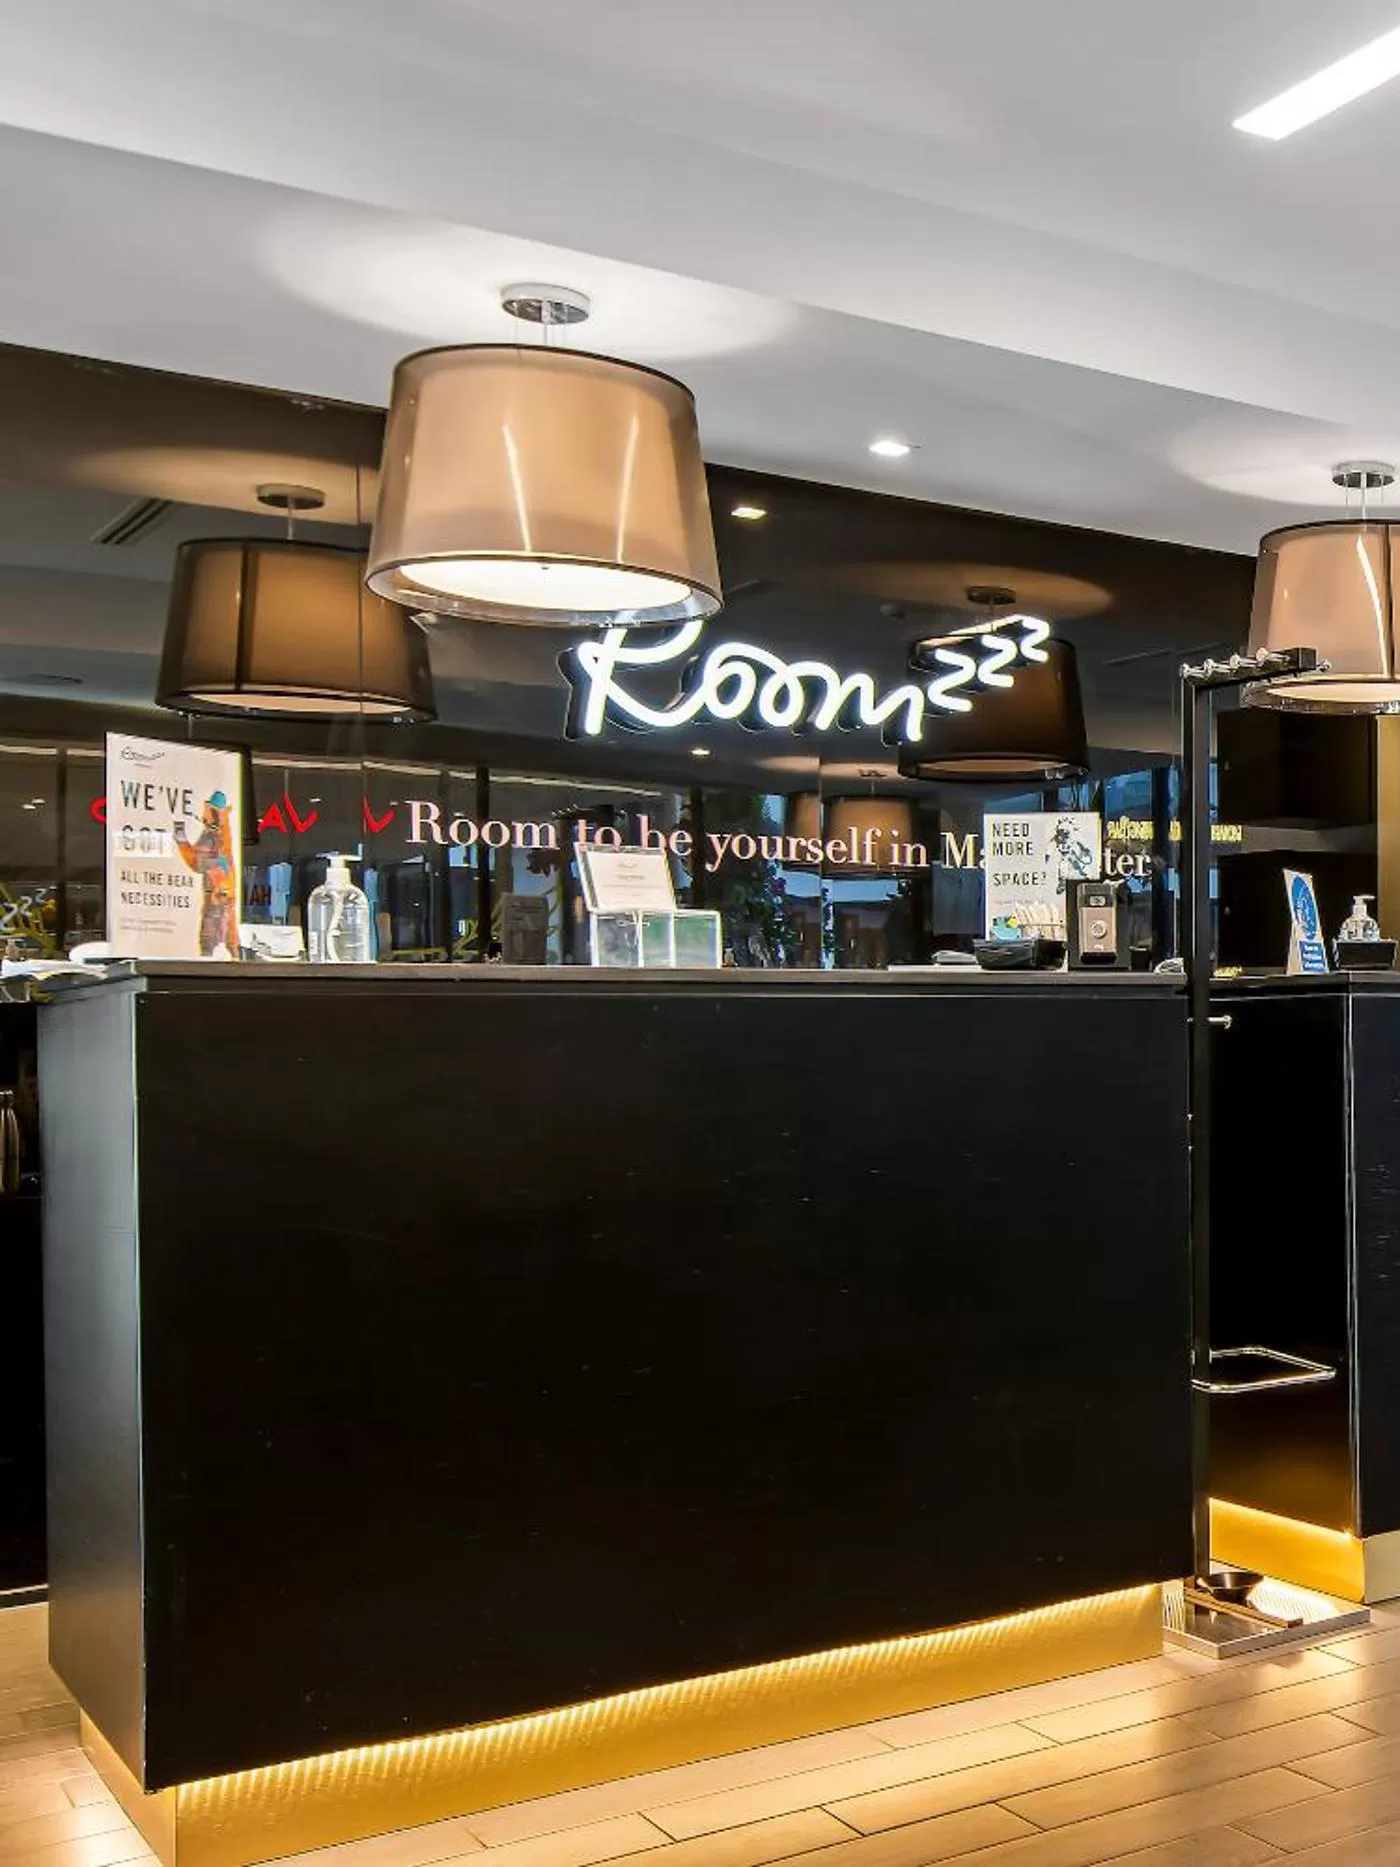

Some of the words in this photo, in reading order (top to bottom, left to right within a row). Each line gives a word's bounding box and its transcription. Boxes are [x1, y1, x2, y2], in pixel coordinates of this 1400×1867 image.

[120, 779, 193, 816] WE'VE
[404, 800, 561, 850] Room
[577, 818, 623, 852] to
[636, 814, 693, 856] be
[705, 826, 882, 872] yourself
[888, 830, 930, 868] in
[992, 822, 1030, 838] NEED
[121, 824, 167, 855] GOT
[992, 841, 1034, 856] MORE
[120, 870, 139, 884] ALL
[143, 872, 163, 886] THE
[167, 874, 194, 888] BEAR
[992, 871, 1047, 887] SPACE?
[120, 891, 190, 908] NECESSITIES
